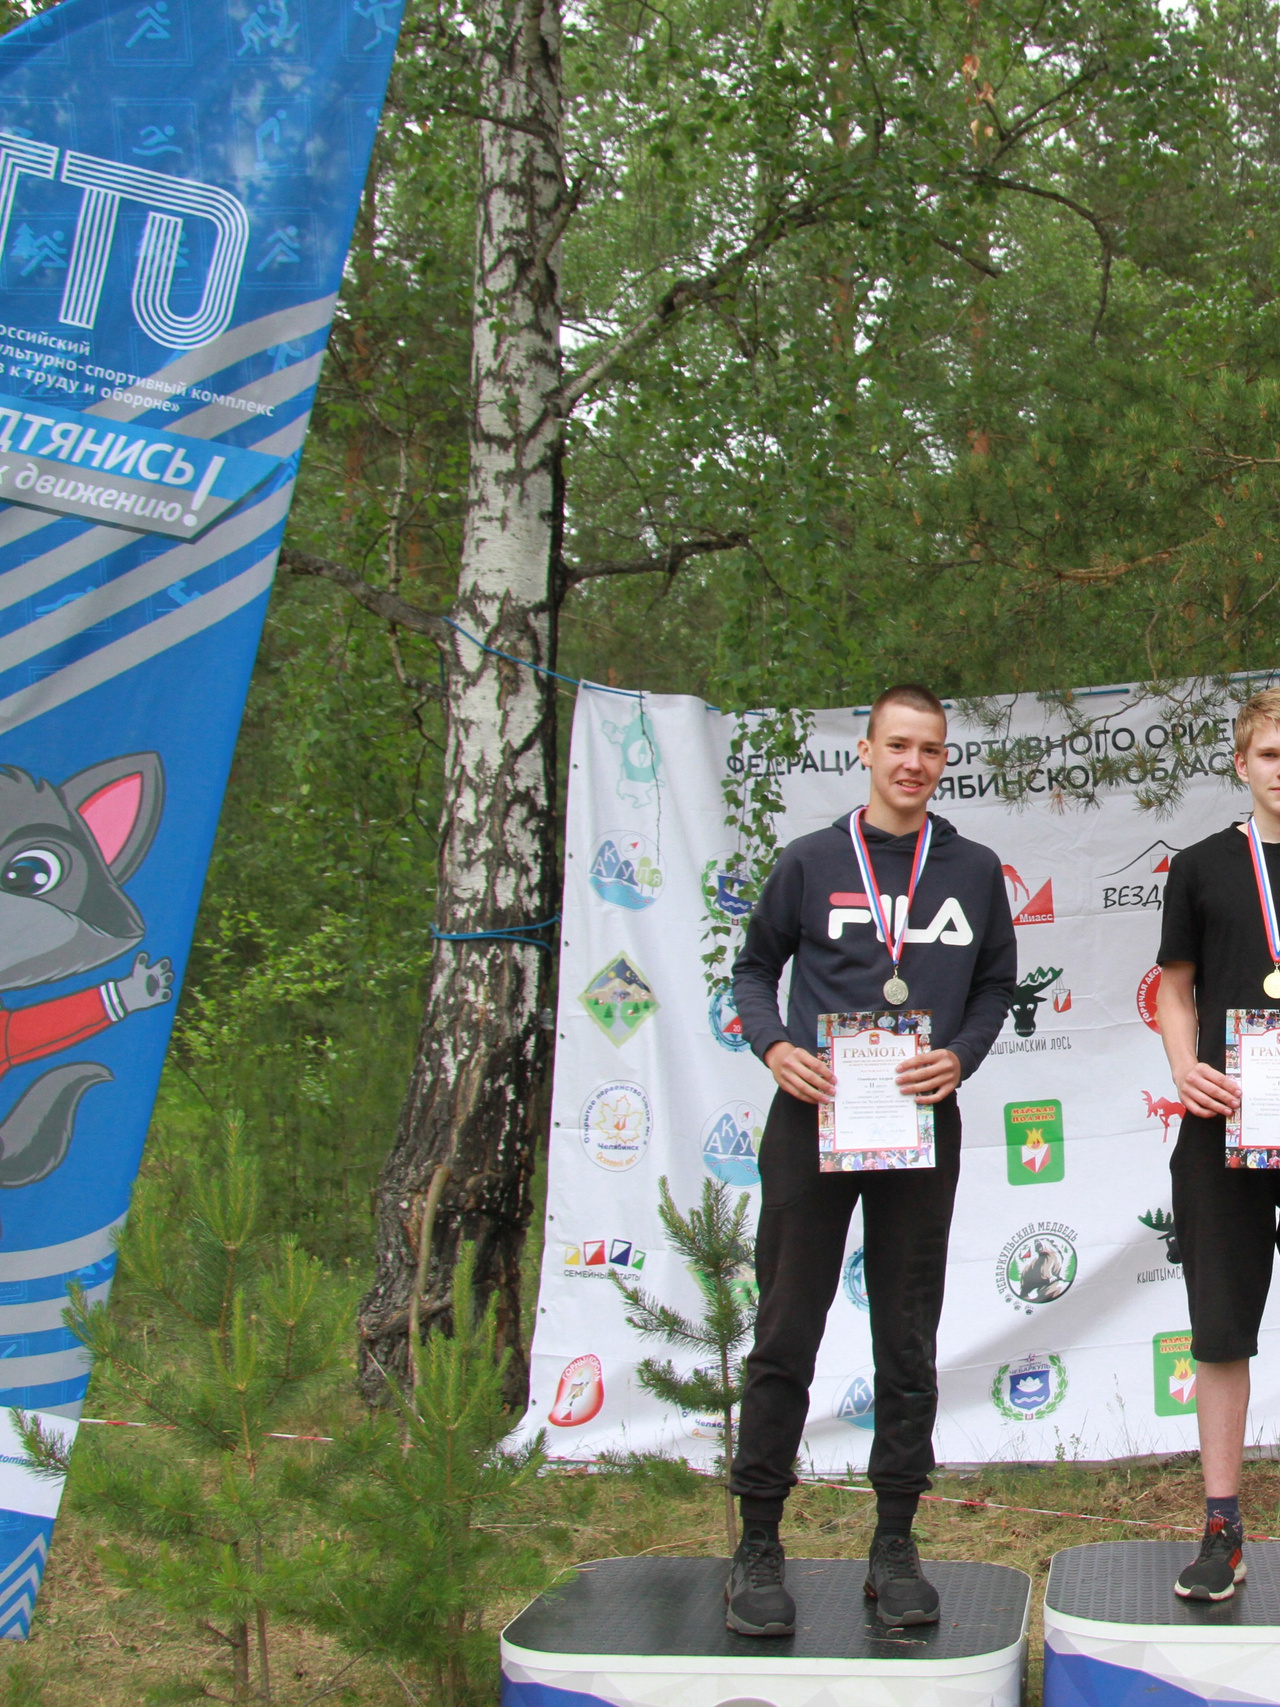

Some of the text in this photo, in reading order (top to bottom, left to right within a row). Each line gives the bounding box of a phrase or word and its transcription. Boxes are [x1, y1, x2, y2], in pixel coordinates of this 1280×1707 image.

[25, 368, 80, 394] труду
[83, 383, 96, 396] и
[101, 387, 181, 413] обороне»
[191, 388, 275, 417] комплекс
[726, 749, 868, 778] ФЕДЕРАЦИ
[943, 726, 1136, 767] ОРТИВНОГО
[1125, 750, 1236, 785] ОБЛАС
[1103, 884, 1163, 911] ВЕЗД
[827, 891, 975, 947] FILA
[1019, 913, 1054, 924] Миасс
[1138, 983, 1153, 1023] ГОРЯЧАЯ
[841, 1046, 907, 1059] ГРАМОТА
[1011, 1105, 1056, 1116] МАЙСКАЯ
[1011, 1114, 1056, 1123] ПОЛЯНА
[995, 1221, 1079, 1295] ЧЕБАРКУЛЬСКИЙ МЕДВЕДЬ
[1136, 1265, 1184, 1284] КЫШТЫМС
[1160, 1336, 1192, 1346] МАЙСК
[1160, 1344, 1191, 1354] ПОЛЯ
